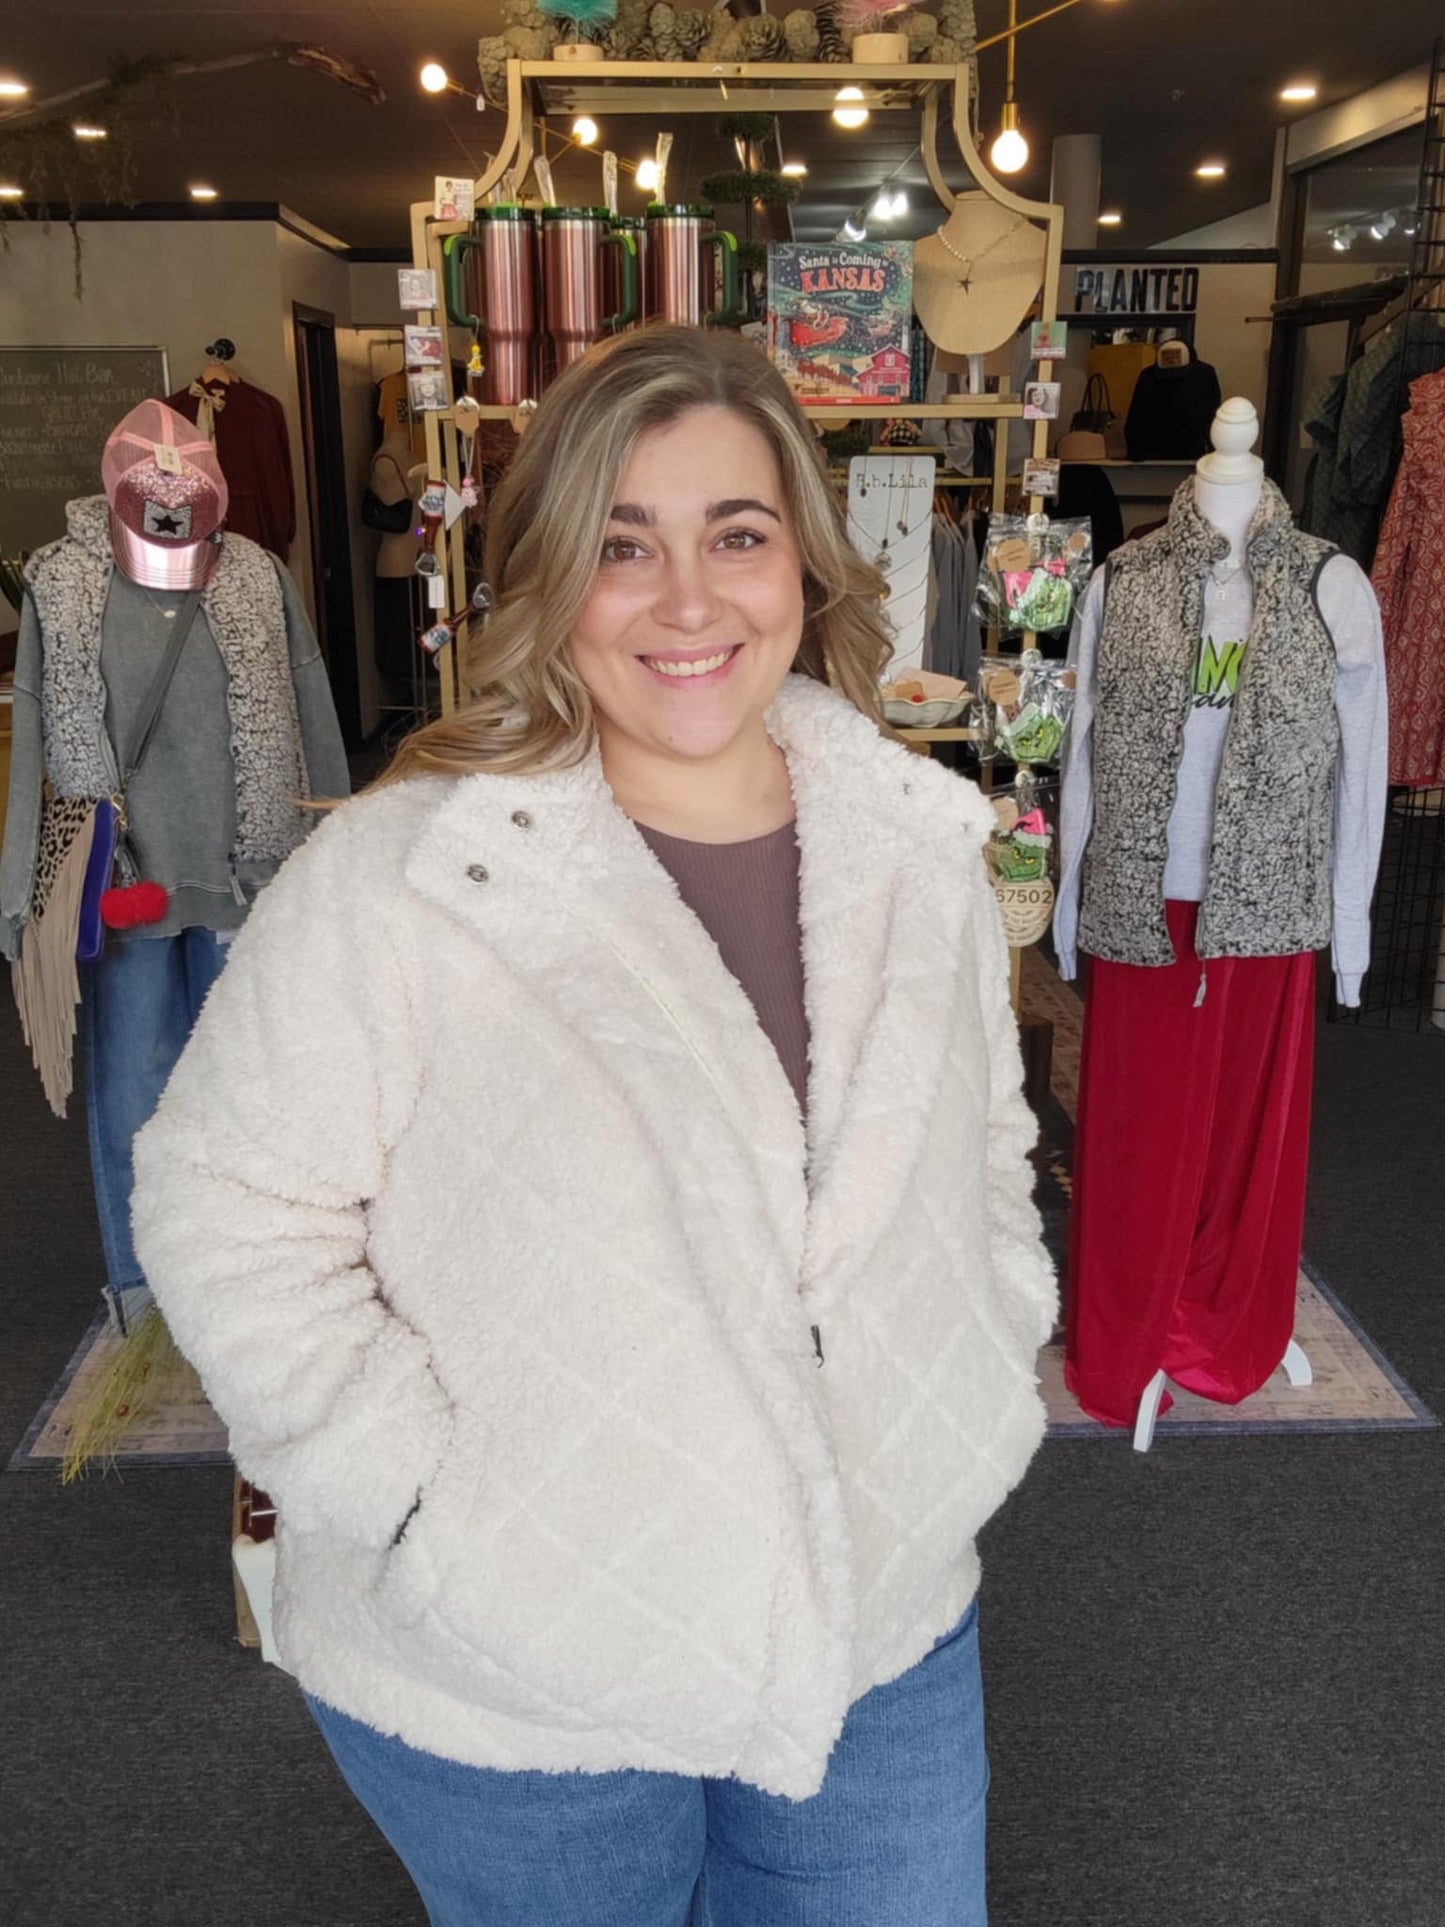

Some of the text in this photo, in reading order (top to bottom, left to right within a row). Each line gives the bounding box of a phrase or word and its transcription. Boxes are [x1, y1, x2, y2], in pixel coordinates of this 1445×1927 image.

[799, 255, 831, 270] Santa
[839, 251, 881, 269] Coming
[800, 268, 886, 294] KANSAS
[1074, 266, 1200, 313] PLANTED
[995, 887, 1053, 905] 67502
